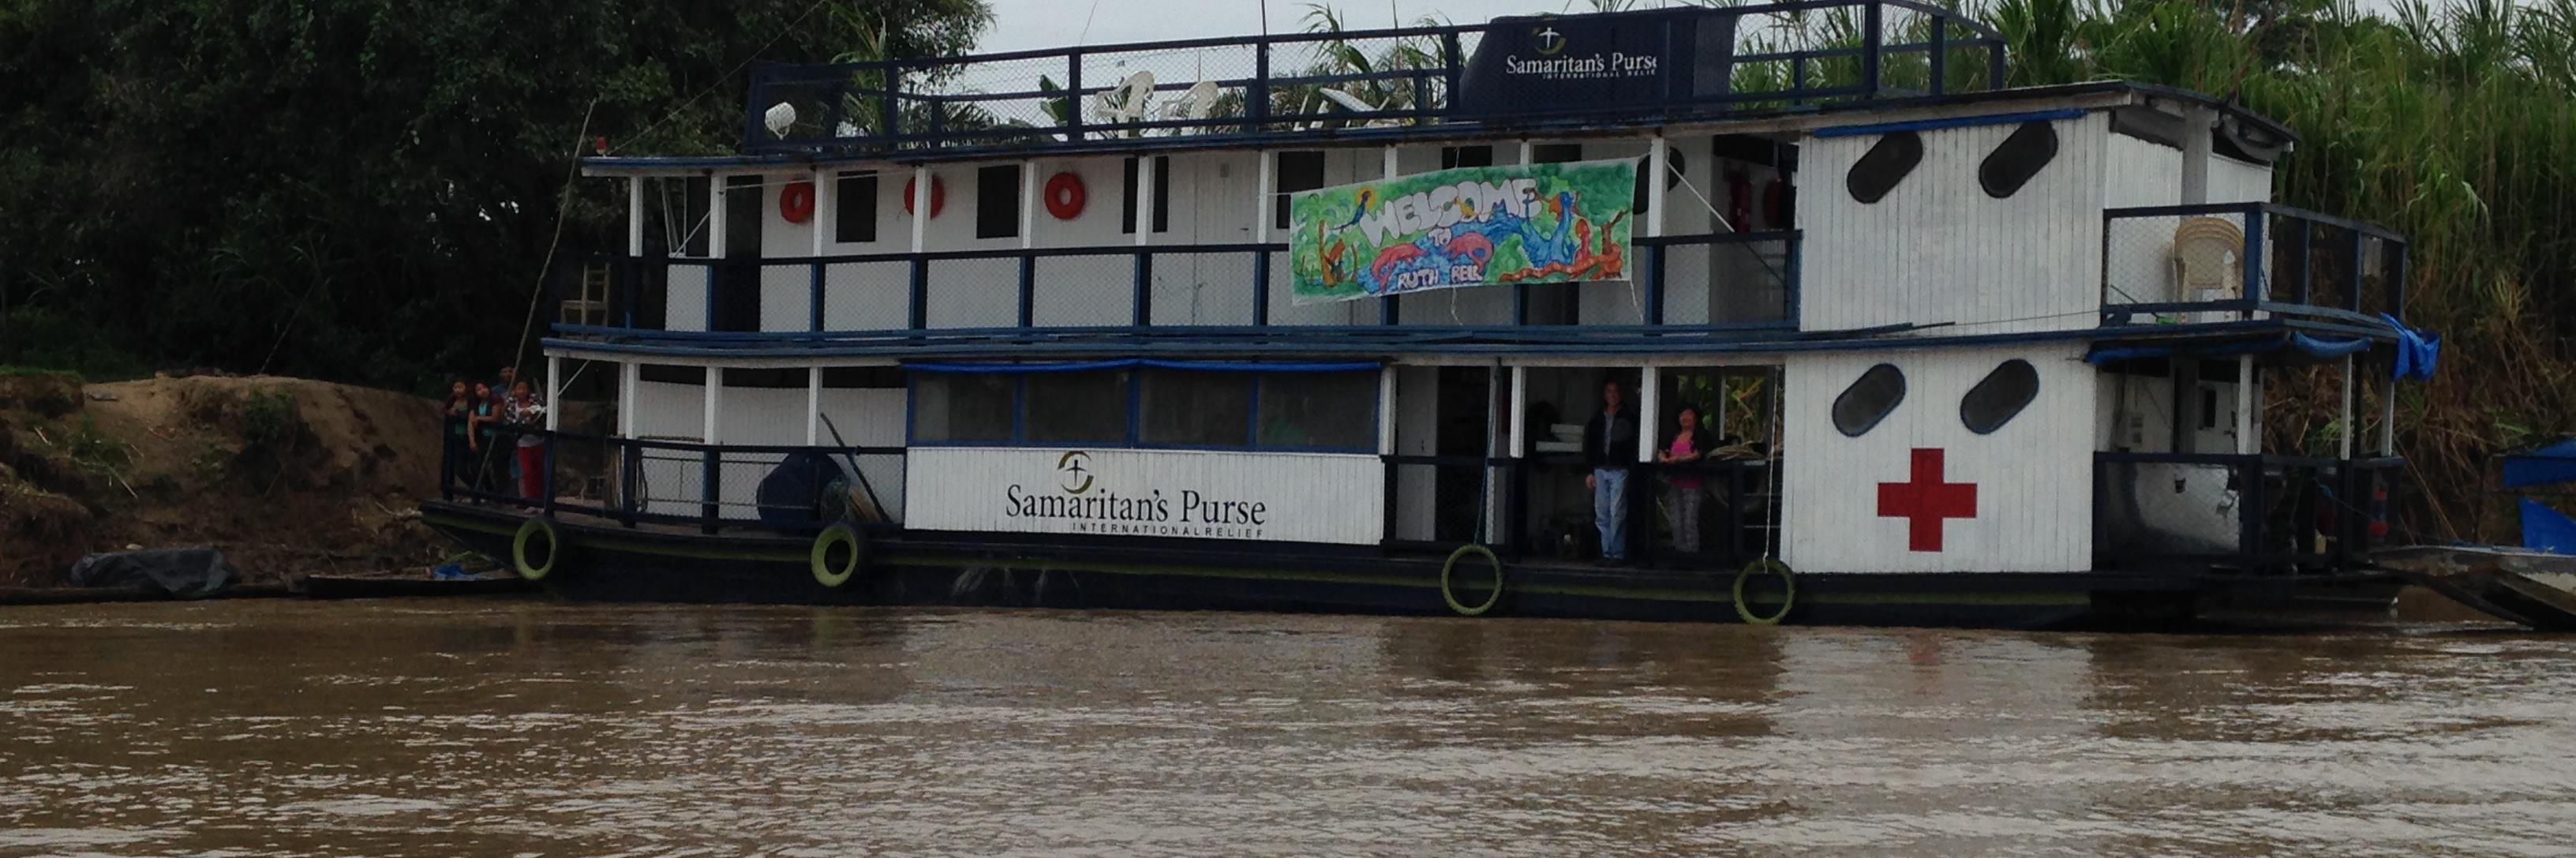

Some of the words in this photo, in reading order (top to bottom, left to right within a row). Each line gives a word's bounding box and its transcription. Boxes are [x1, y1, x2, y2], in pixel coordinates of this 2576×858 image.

[1507, 53, 1604, 74] Samaritan's
[1360, 178, 1543, 248] WELCOME
[1428, 227, 1452, 247] TO
[1398, 268, 1440, 290] RUTH
[1006, 484, 1169, 523] Samaritan's
[1180, 489, 1267, 526] Purse
